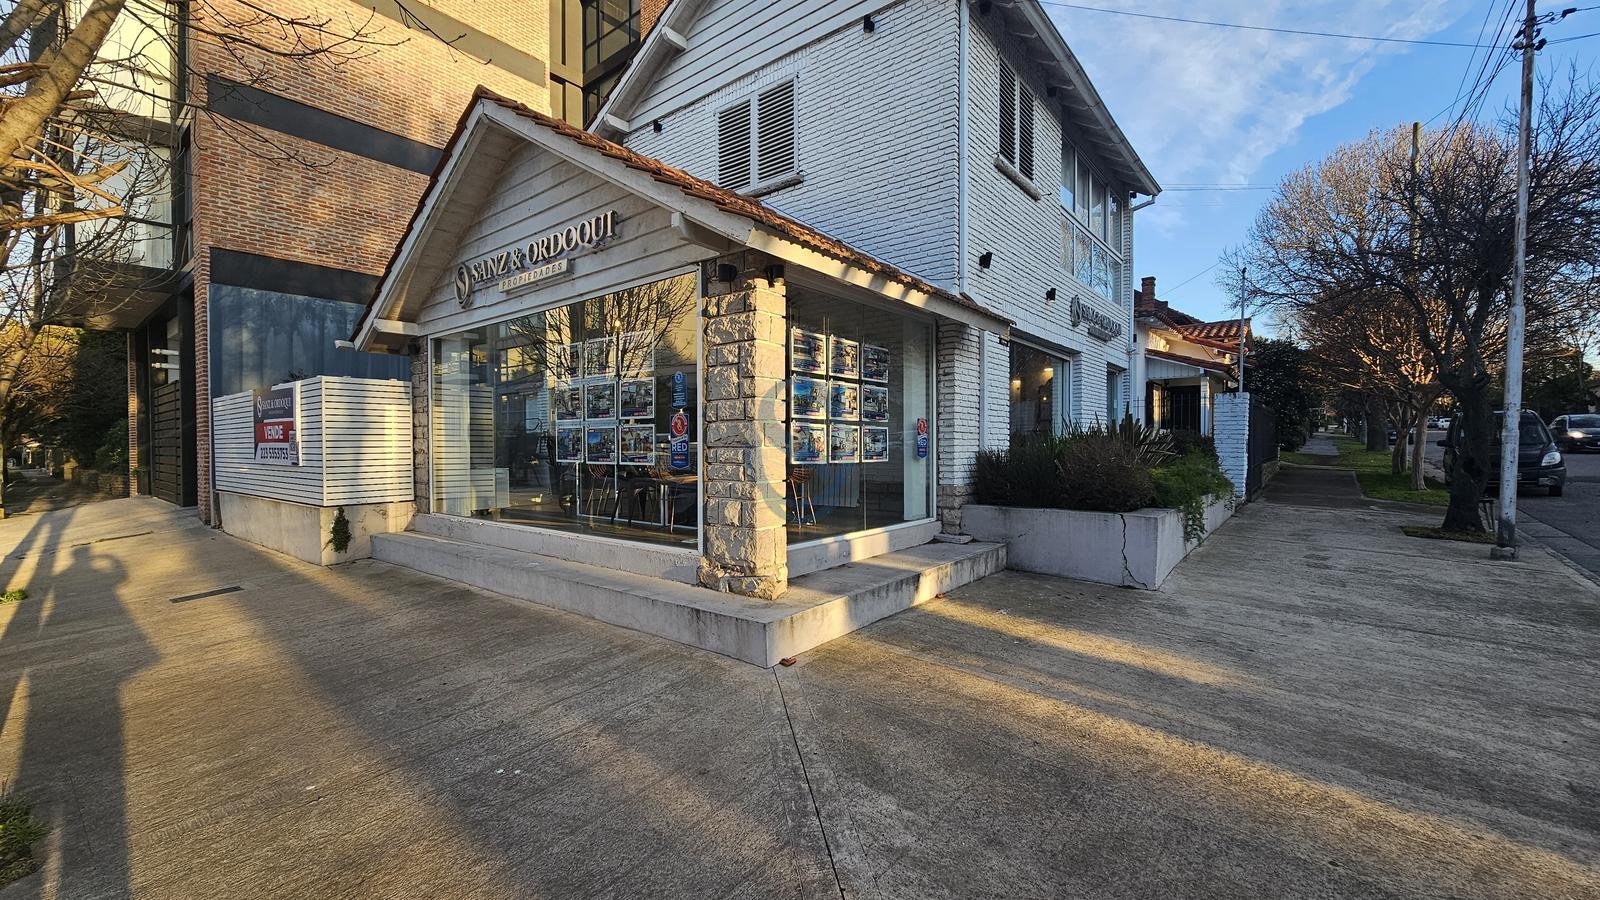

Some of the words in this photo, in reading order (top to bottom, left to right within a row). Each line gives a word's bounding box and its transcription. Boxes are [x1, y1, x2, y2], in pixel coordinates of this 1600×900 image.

[472, 251, 510, 282] SANZ
[510, 247, 524, 270] &
[526, 210, 617, 264] ORDOQUI
[501, 261, 563, 290] PROPIEDADES
[264, 425, 284, 440] VENDE
[672, 442, 688, 452] RED
